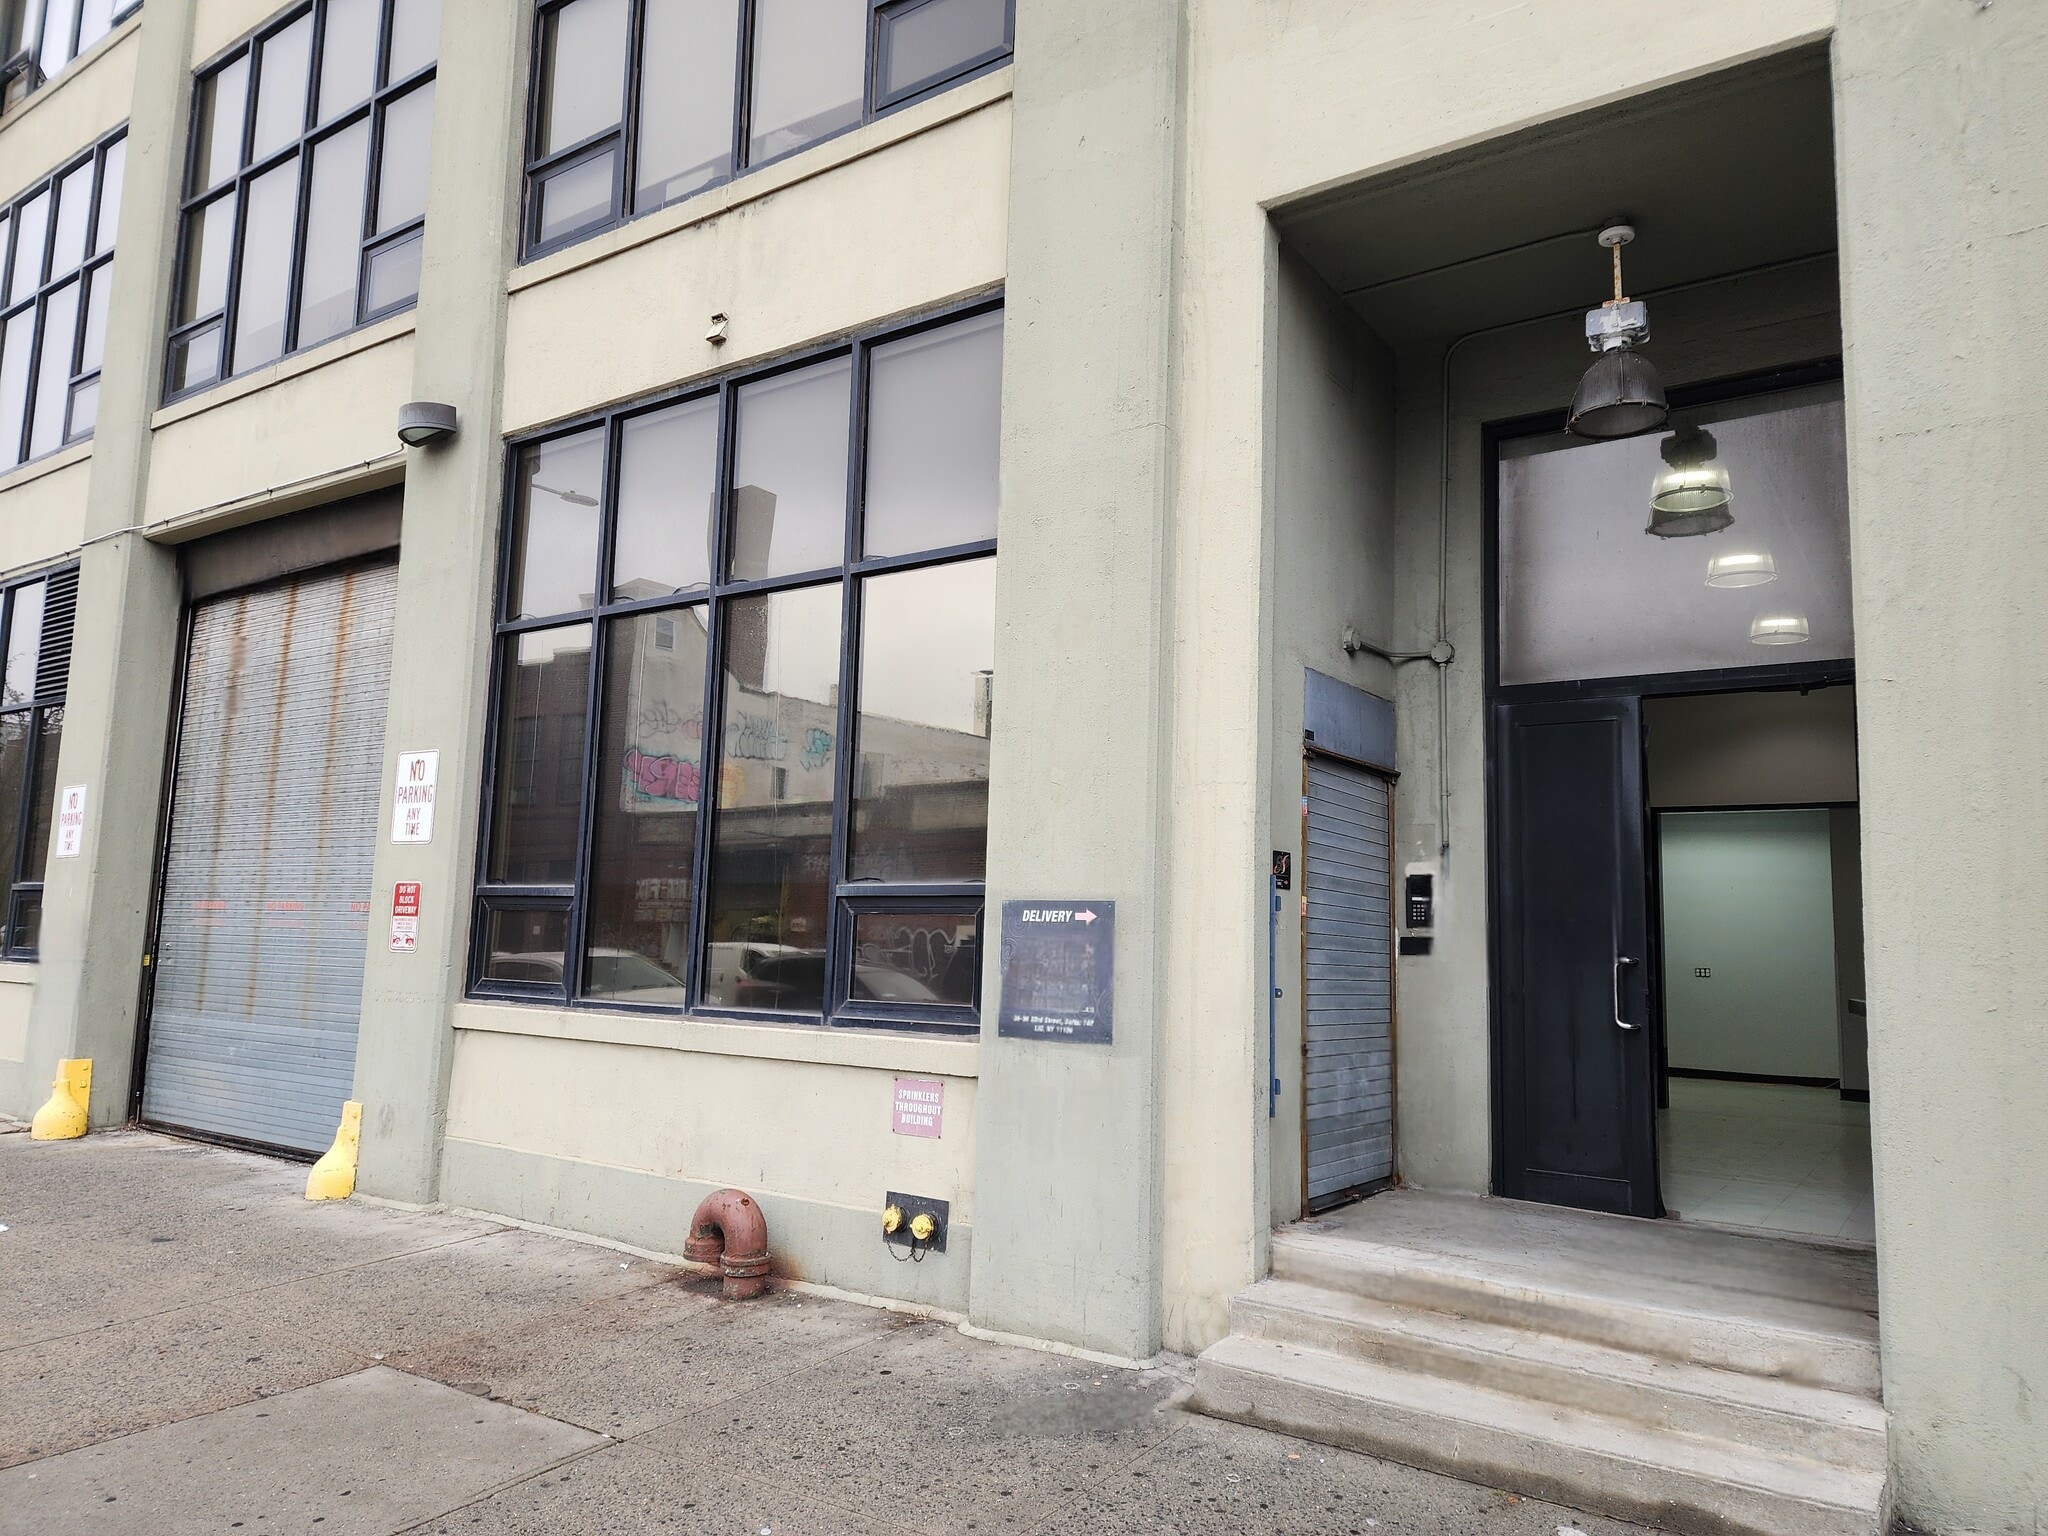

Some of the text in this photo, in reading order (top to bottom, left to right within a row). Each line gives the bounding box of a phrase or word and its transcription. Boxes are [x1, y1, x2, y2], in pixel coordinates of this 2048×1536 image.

[409, 760, 426, 782] NO
[68, 793, 78, 809] NO
[397, 784, 434, 804] PARKING
[61, 812, 82, 826] PARKING
[406, 808, 421, 821] ANY
[405, 822, 420, 836] TIME
[399, 885, 416, 894] DO NOT
[399, 895, 415, 904] BLOCK
[395, 905, 417, 914] DRIVEWAY
[1022, 909, 1072, 922] DELIVERY
[898, 1089, 939, 1103] SPRINKLERS
[895, 1101, 941, 1115] THROUGHOUT
[901, 1114, 933, 1126] BUILDING
